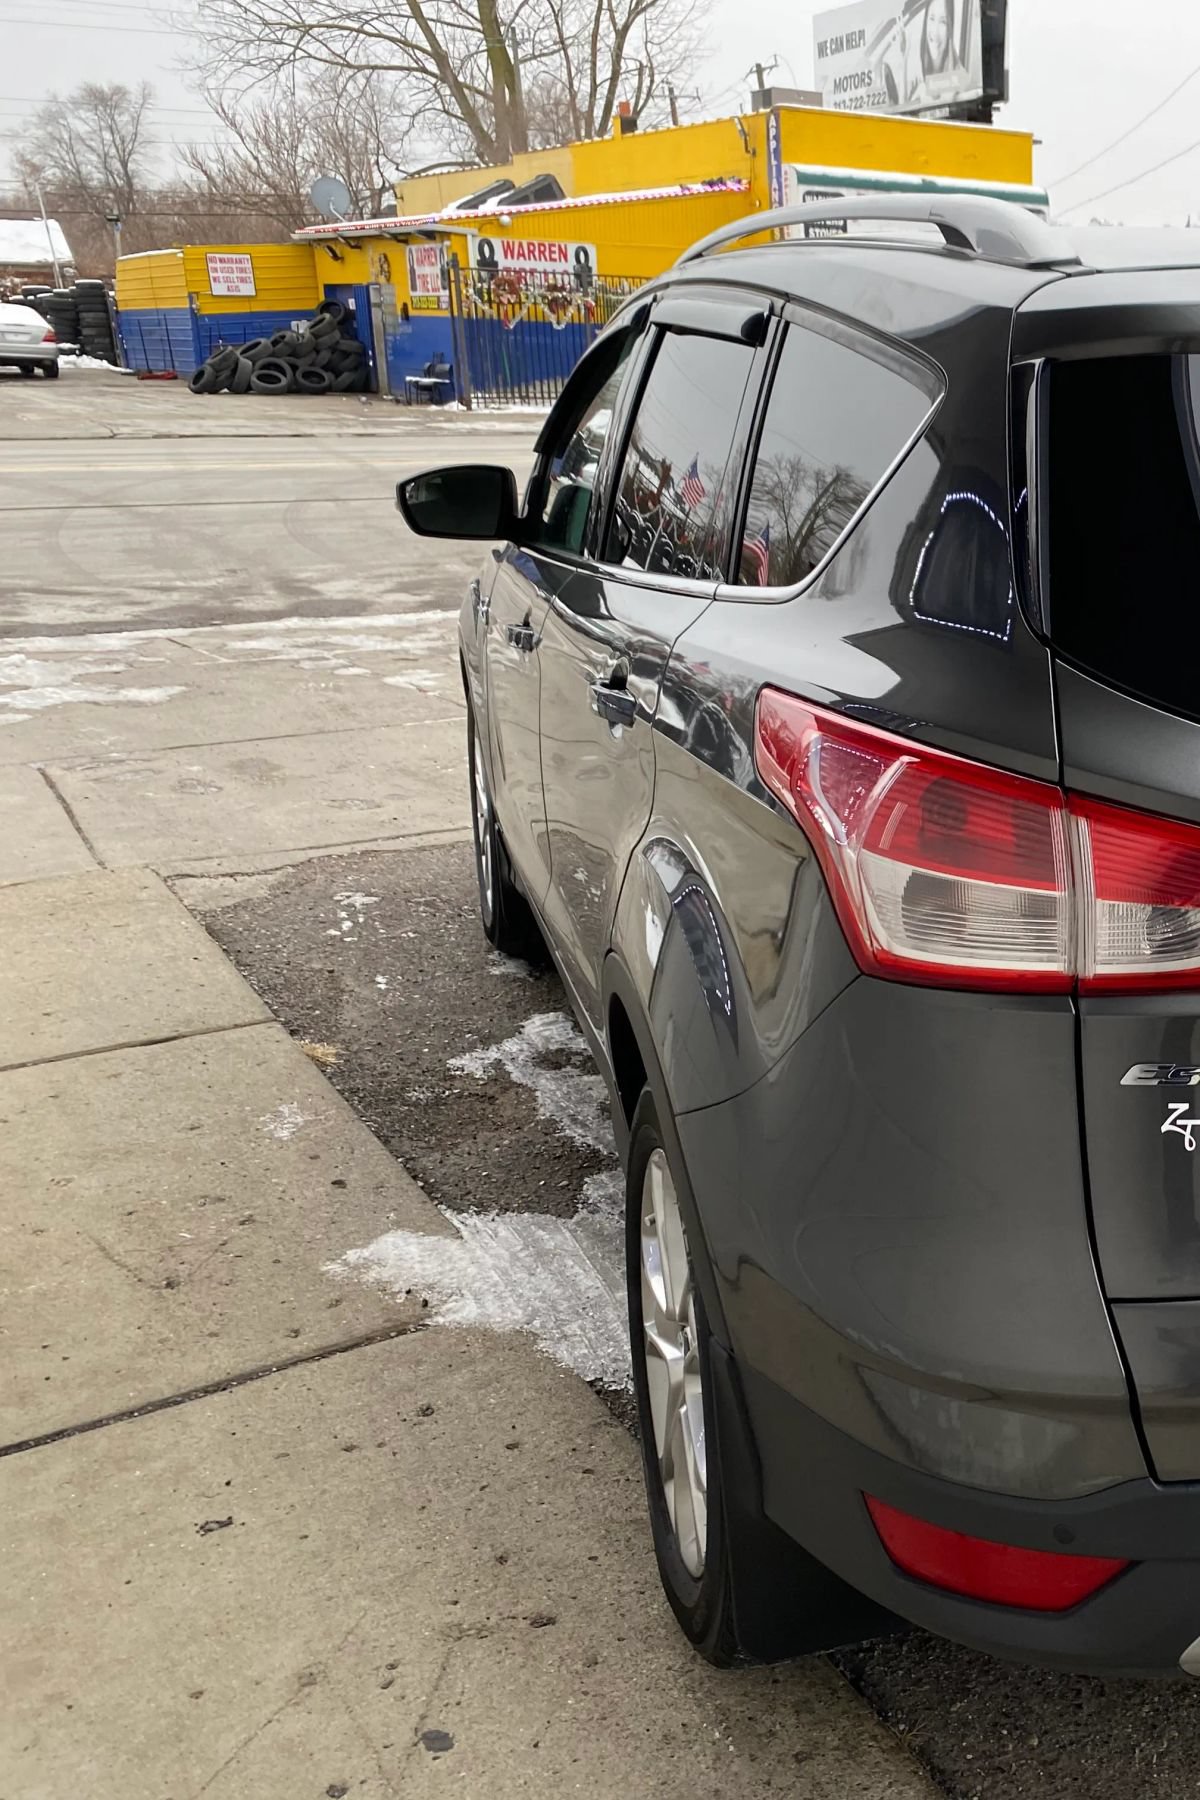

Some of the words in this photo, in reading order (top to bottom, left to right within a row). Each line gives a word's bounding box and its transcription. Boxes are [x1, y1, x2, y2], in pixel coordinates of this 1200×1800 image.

[817, 40, 829, 59] WE
[829, 34, 844, 56] CAN
[845, 29, 866, 51] HELP!
[833, 69, 872, 95] MOTORS
[218, 257, 250, 265] WARRANTY
[415, 247, 438, 266] WARREN
[501, 240, 569, 264] WARREN
